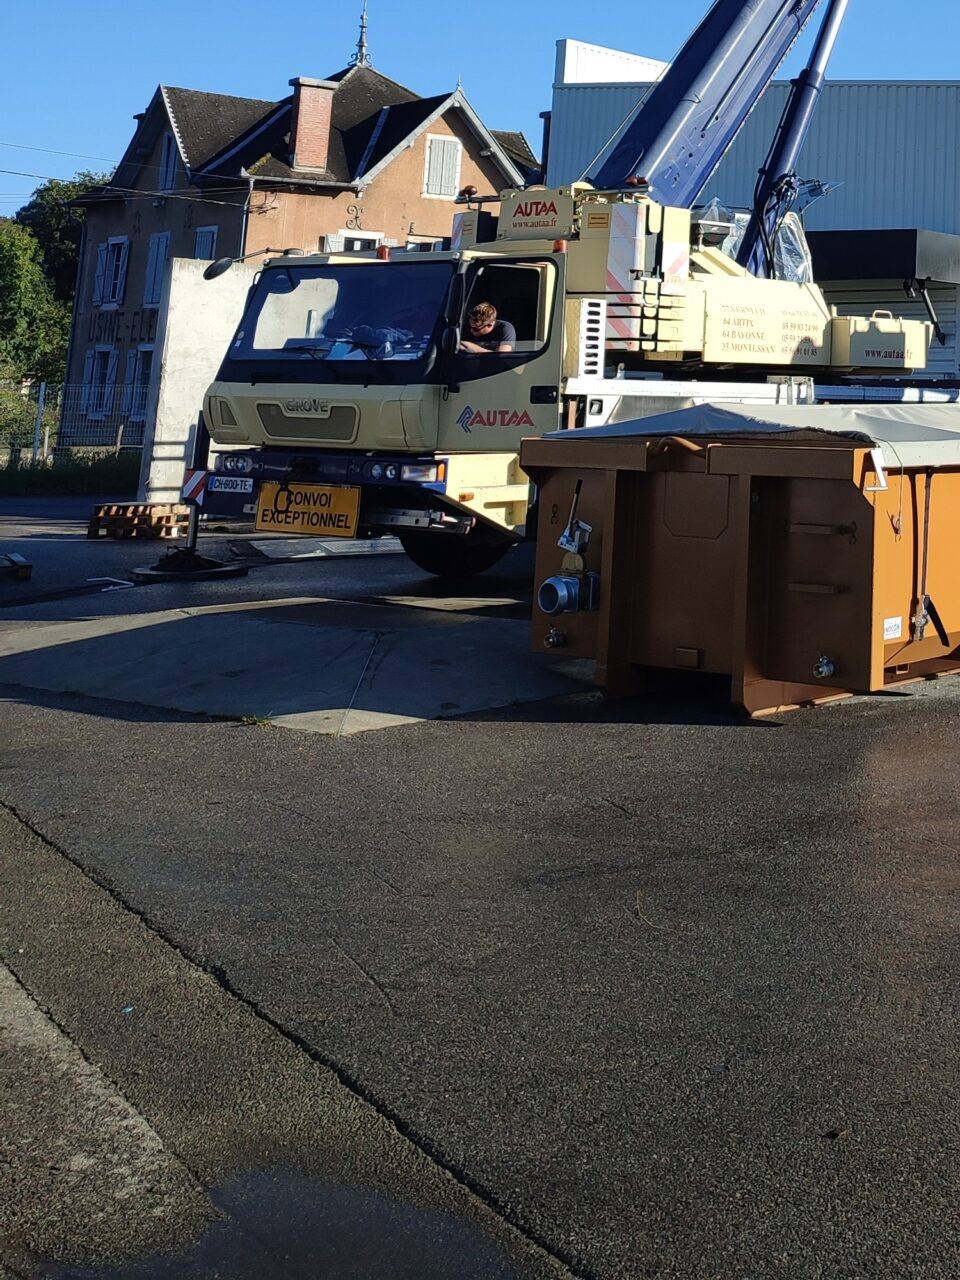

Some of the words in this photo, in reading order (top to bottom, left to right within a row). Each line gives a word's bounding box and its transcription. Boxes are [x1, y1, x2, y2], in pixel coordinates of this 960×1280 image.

[512, 201, 558, 218] AUTAA
[512, 218, 557, 228] www.autaa.fr
[722, 330, 730, 338] 64
[731, 330, 767, 341] BAYONNE
[864, 349, 913, 359] www.autaa.fr
[285, 399, 329, 413] GROVE
[469, 409, 535, 427] AUTAA
[261, 508, 351, 529] EXCEPTIONNEL
